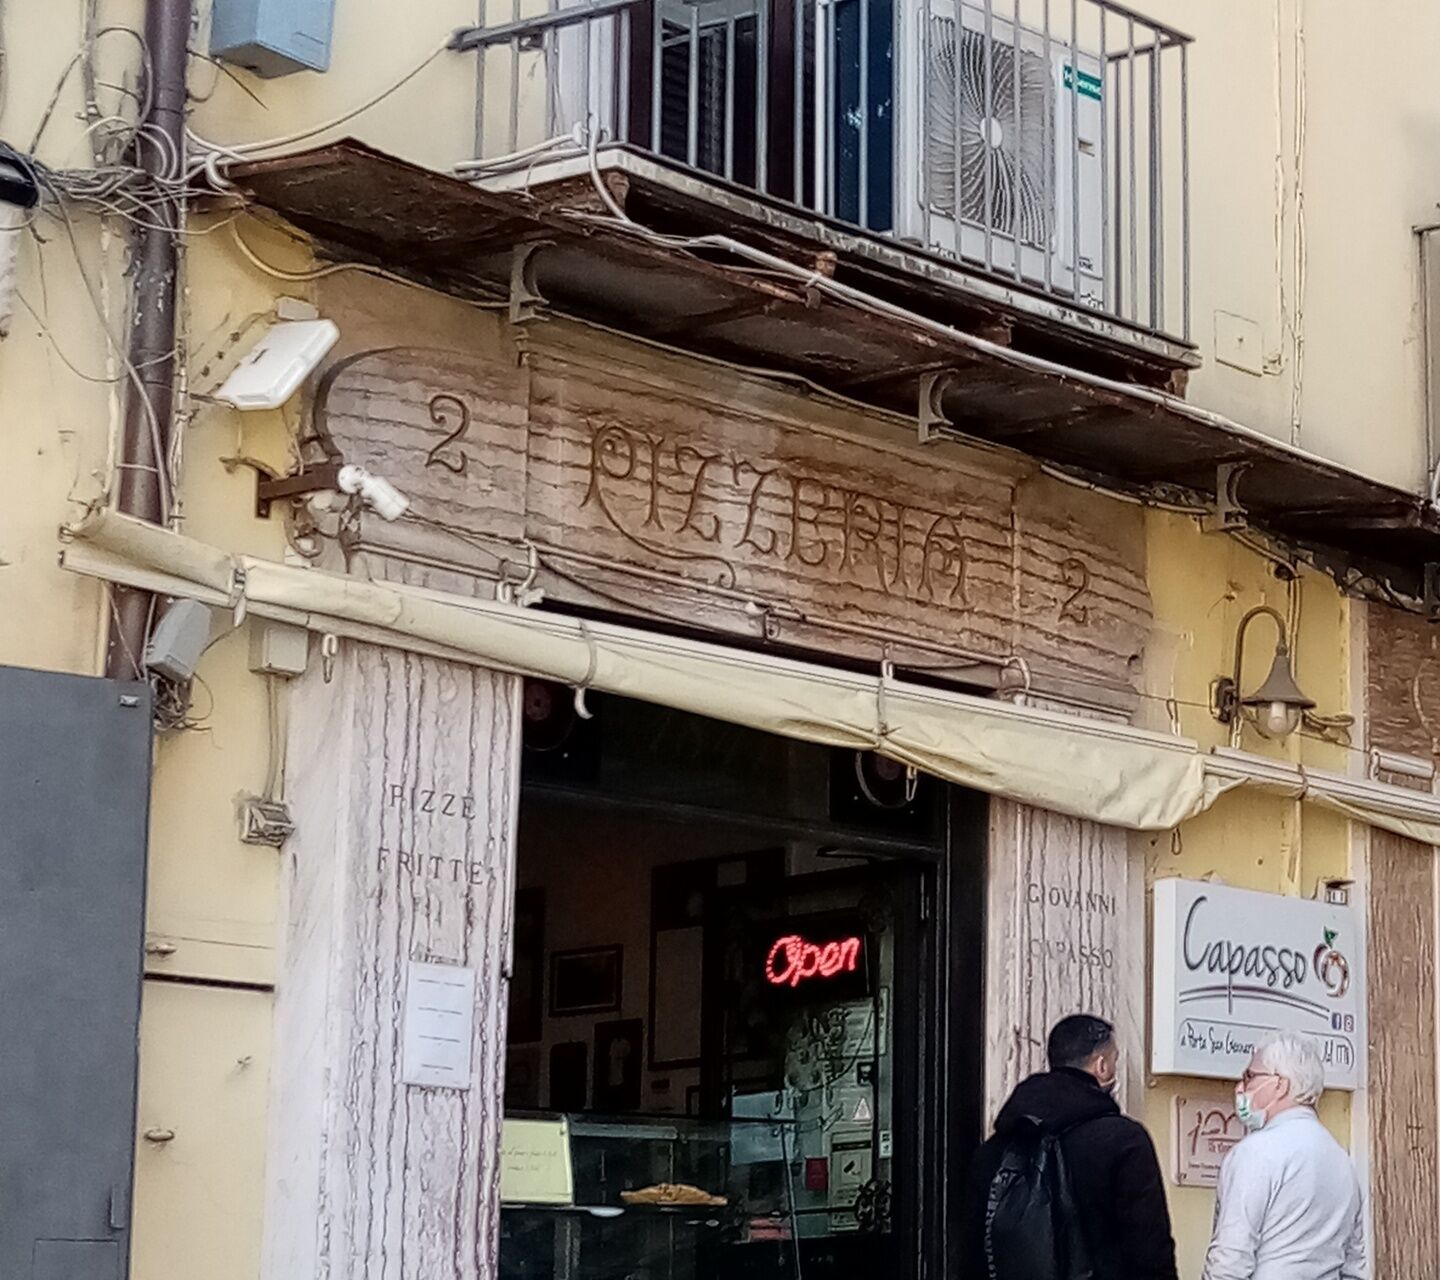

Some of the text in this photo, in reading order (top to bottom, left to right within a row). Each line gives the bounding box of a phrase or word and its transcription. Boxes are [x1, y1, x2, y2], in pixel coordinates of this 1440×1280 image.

[425, 394, 470, 473] 2
[578, 414, 970, 606] PIZZERIA
[388, 783, 476, 820] PIZZE
[376, 847, 485, 885] FRITTE
[1026, 882, 1117, 917] GIOVANNI
[766, 933, 860, 987] Open
[1183, 896, 1307, 1015] Capasso
